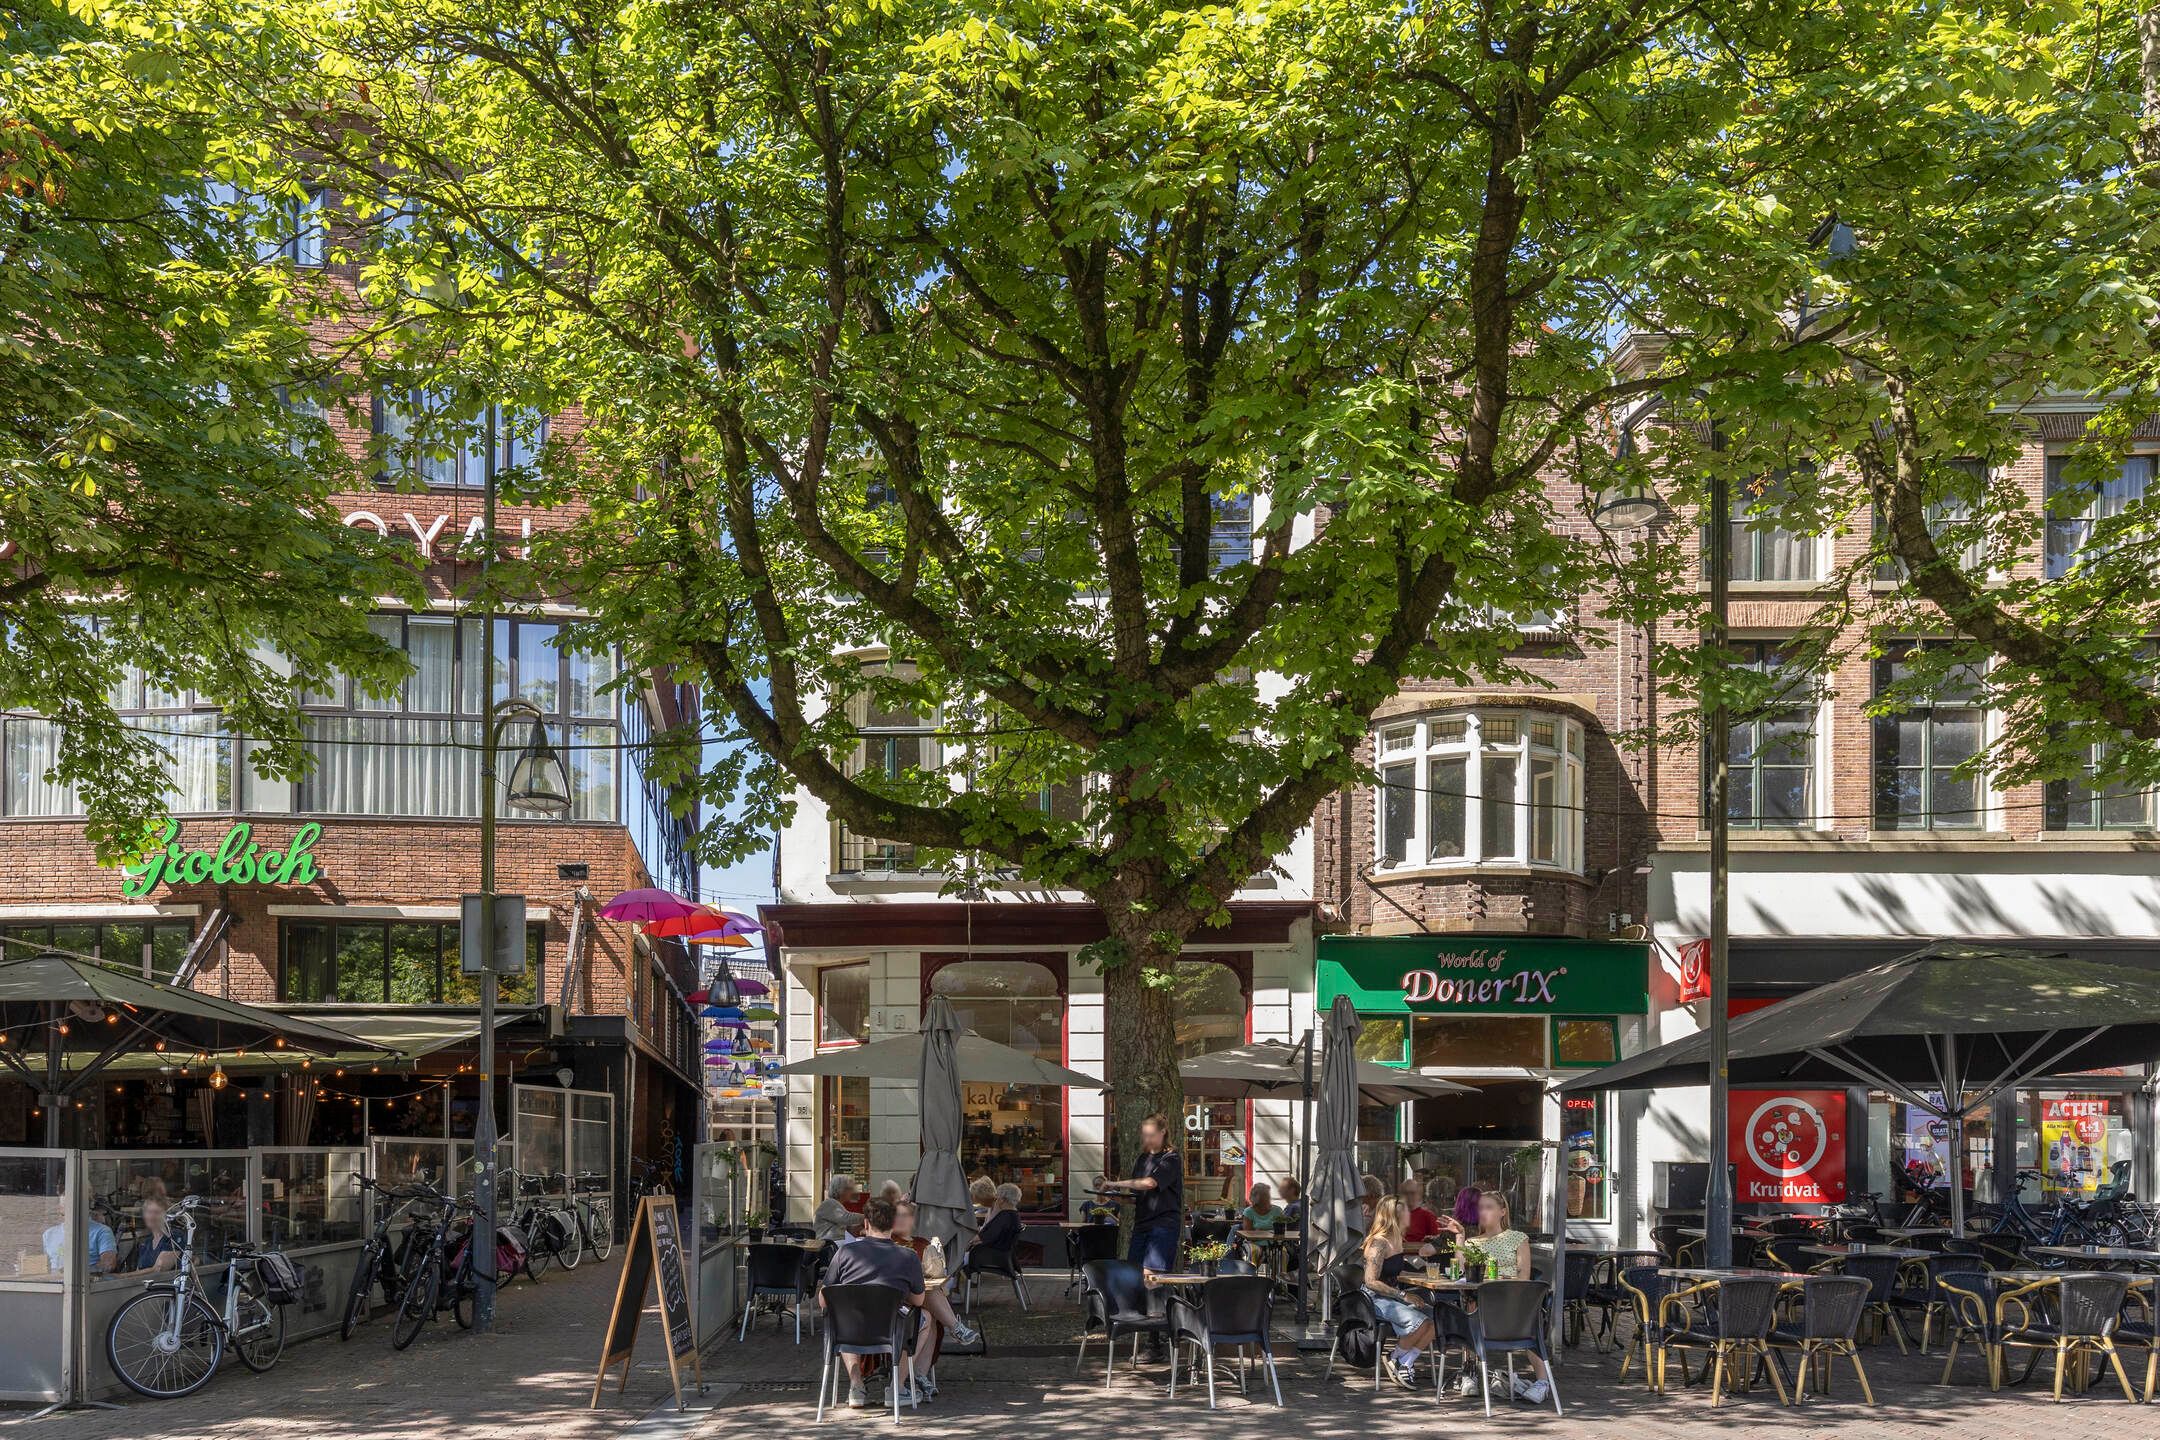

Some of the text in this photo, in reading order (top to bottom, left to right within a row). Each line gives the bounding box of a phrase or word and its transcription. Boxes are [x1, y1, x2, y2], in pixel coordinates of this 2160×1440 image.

[122, 817, 322, 898] Grolsch
[1438, 949, 1508, 972] World of
[1567, 1100, 1595, 1109] OPEN
[2048, 1102, 2103, 1117] ACTIE!
[2079, 1121, 2100, 1133] 1+1
[1749, 1181, 1820, 1197] Kruidvat
